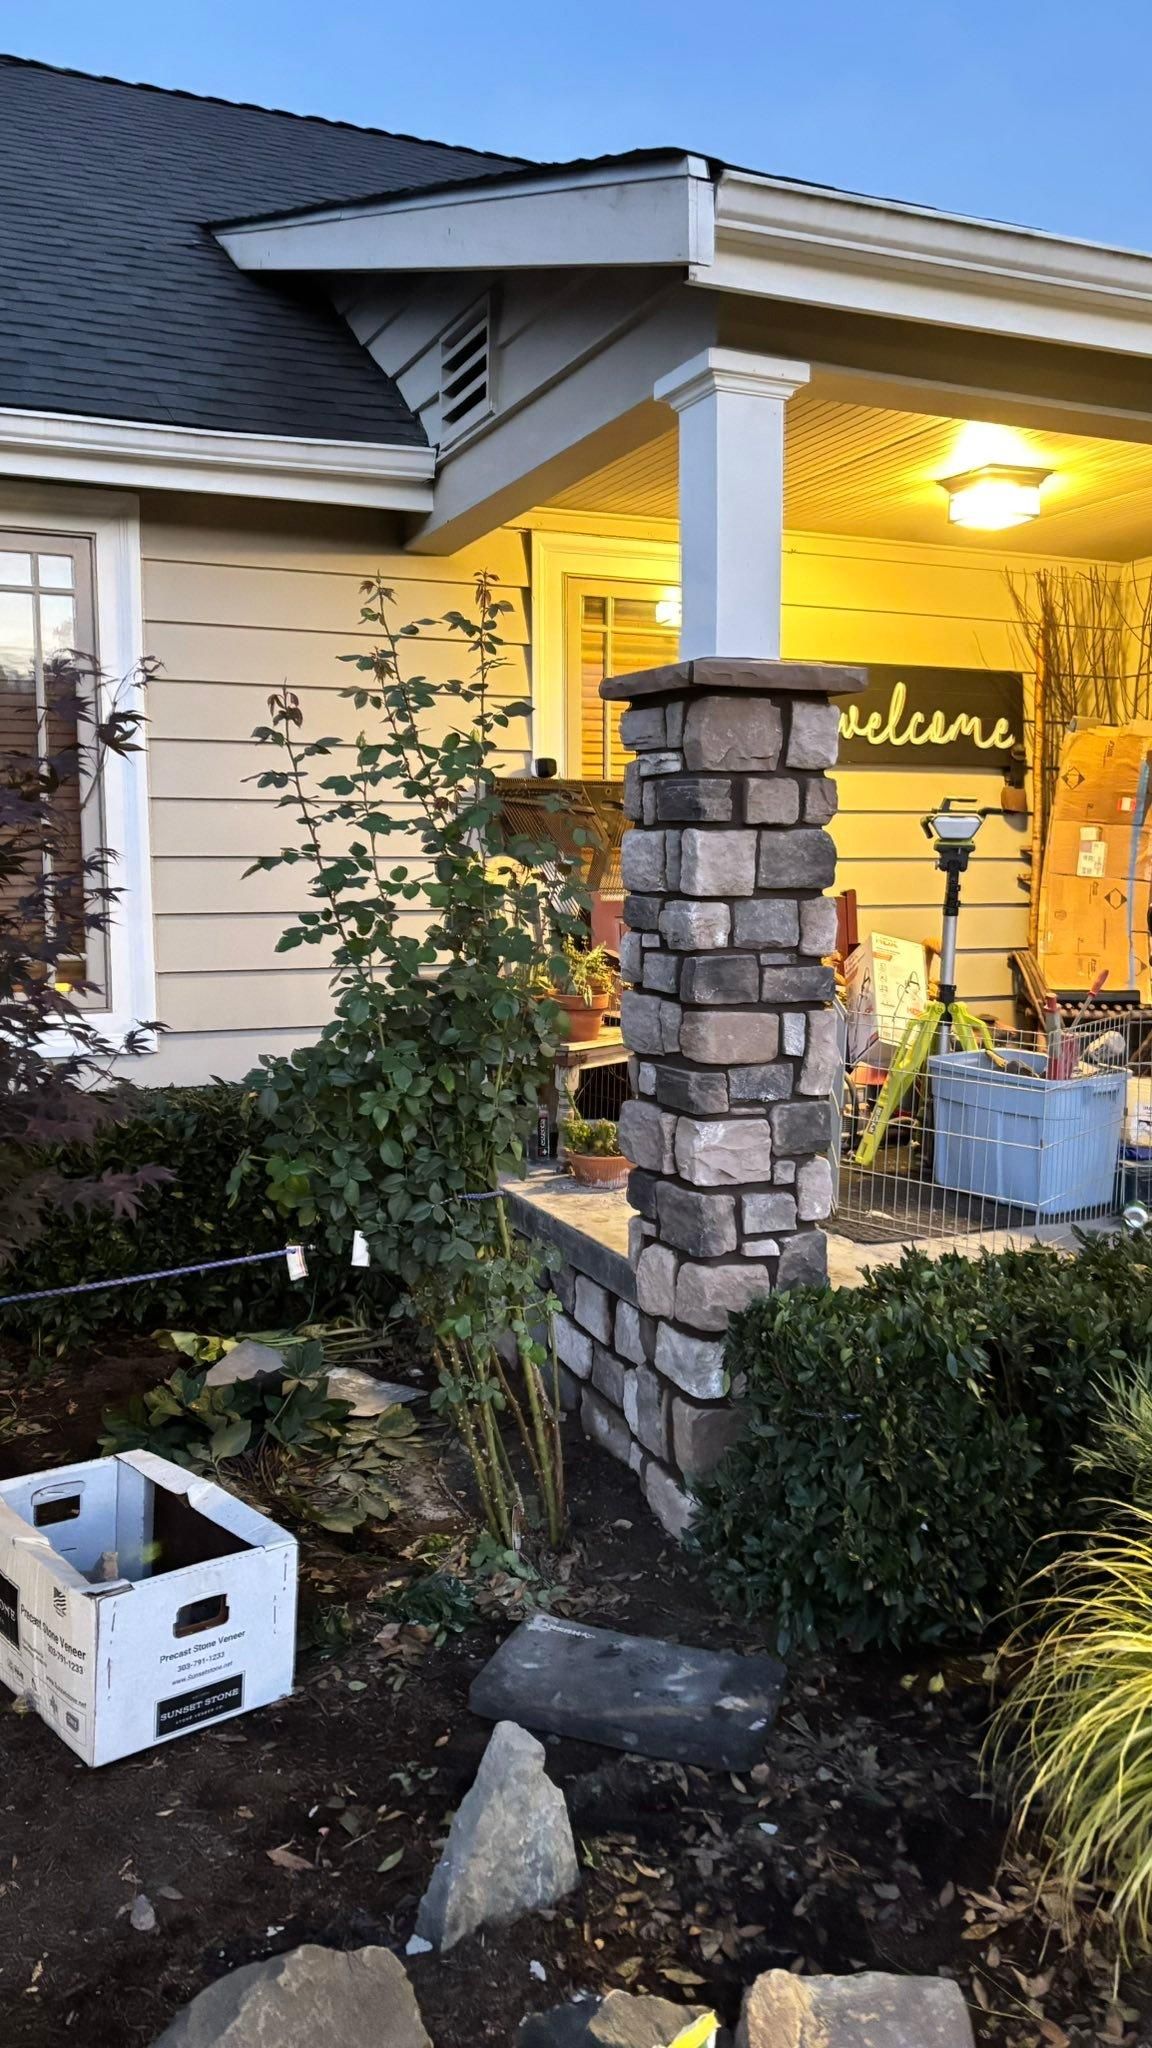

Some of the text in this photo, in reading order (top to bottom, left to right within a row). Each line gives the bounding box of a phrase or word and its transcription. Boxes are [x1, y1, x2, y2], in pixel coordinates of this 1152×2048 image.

[20, 1604, 41, 1630] Precast
[43, 1622, 59, 1644] Stone
[60, 1636, 86, 1660] Veneer
[160, 1630, 246, 1663] Precast Stone Veneer
[177, 1651, 225, 1672] 303-791-1233
[160, 1701, 203, 1721] SUNSET
[204, 1688, 239, 1706] STONE
